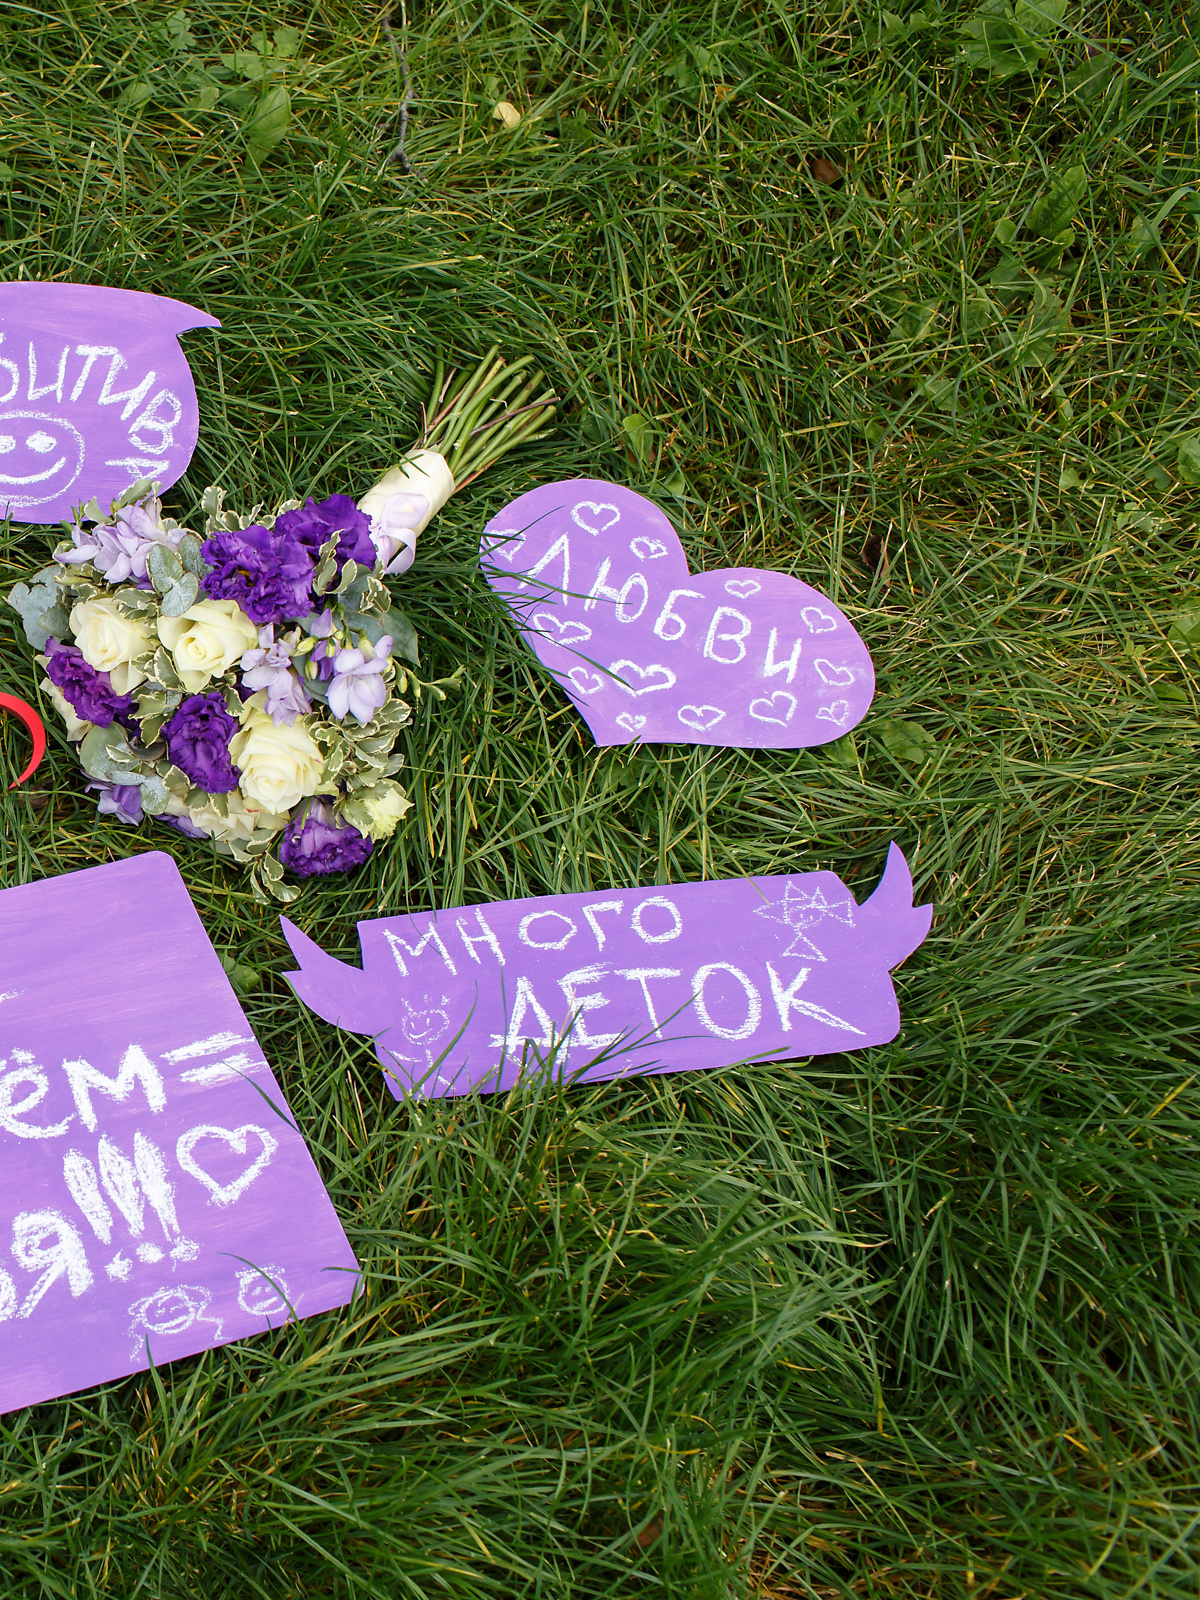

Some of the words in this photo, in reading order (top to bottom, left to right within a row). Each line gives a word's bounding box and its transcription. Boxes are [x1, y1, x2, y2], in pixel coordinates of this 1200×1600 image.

[517, 532, 803, 683] ЛЮБВИ
[383, 896, 683, 976] МНОГО
[489, 962, 866, 1064] ДЕТОК
